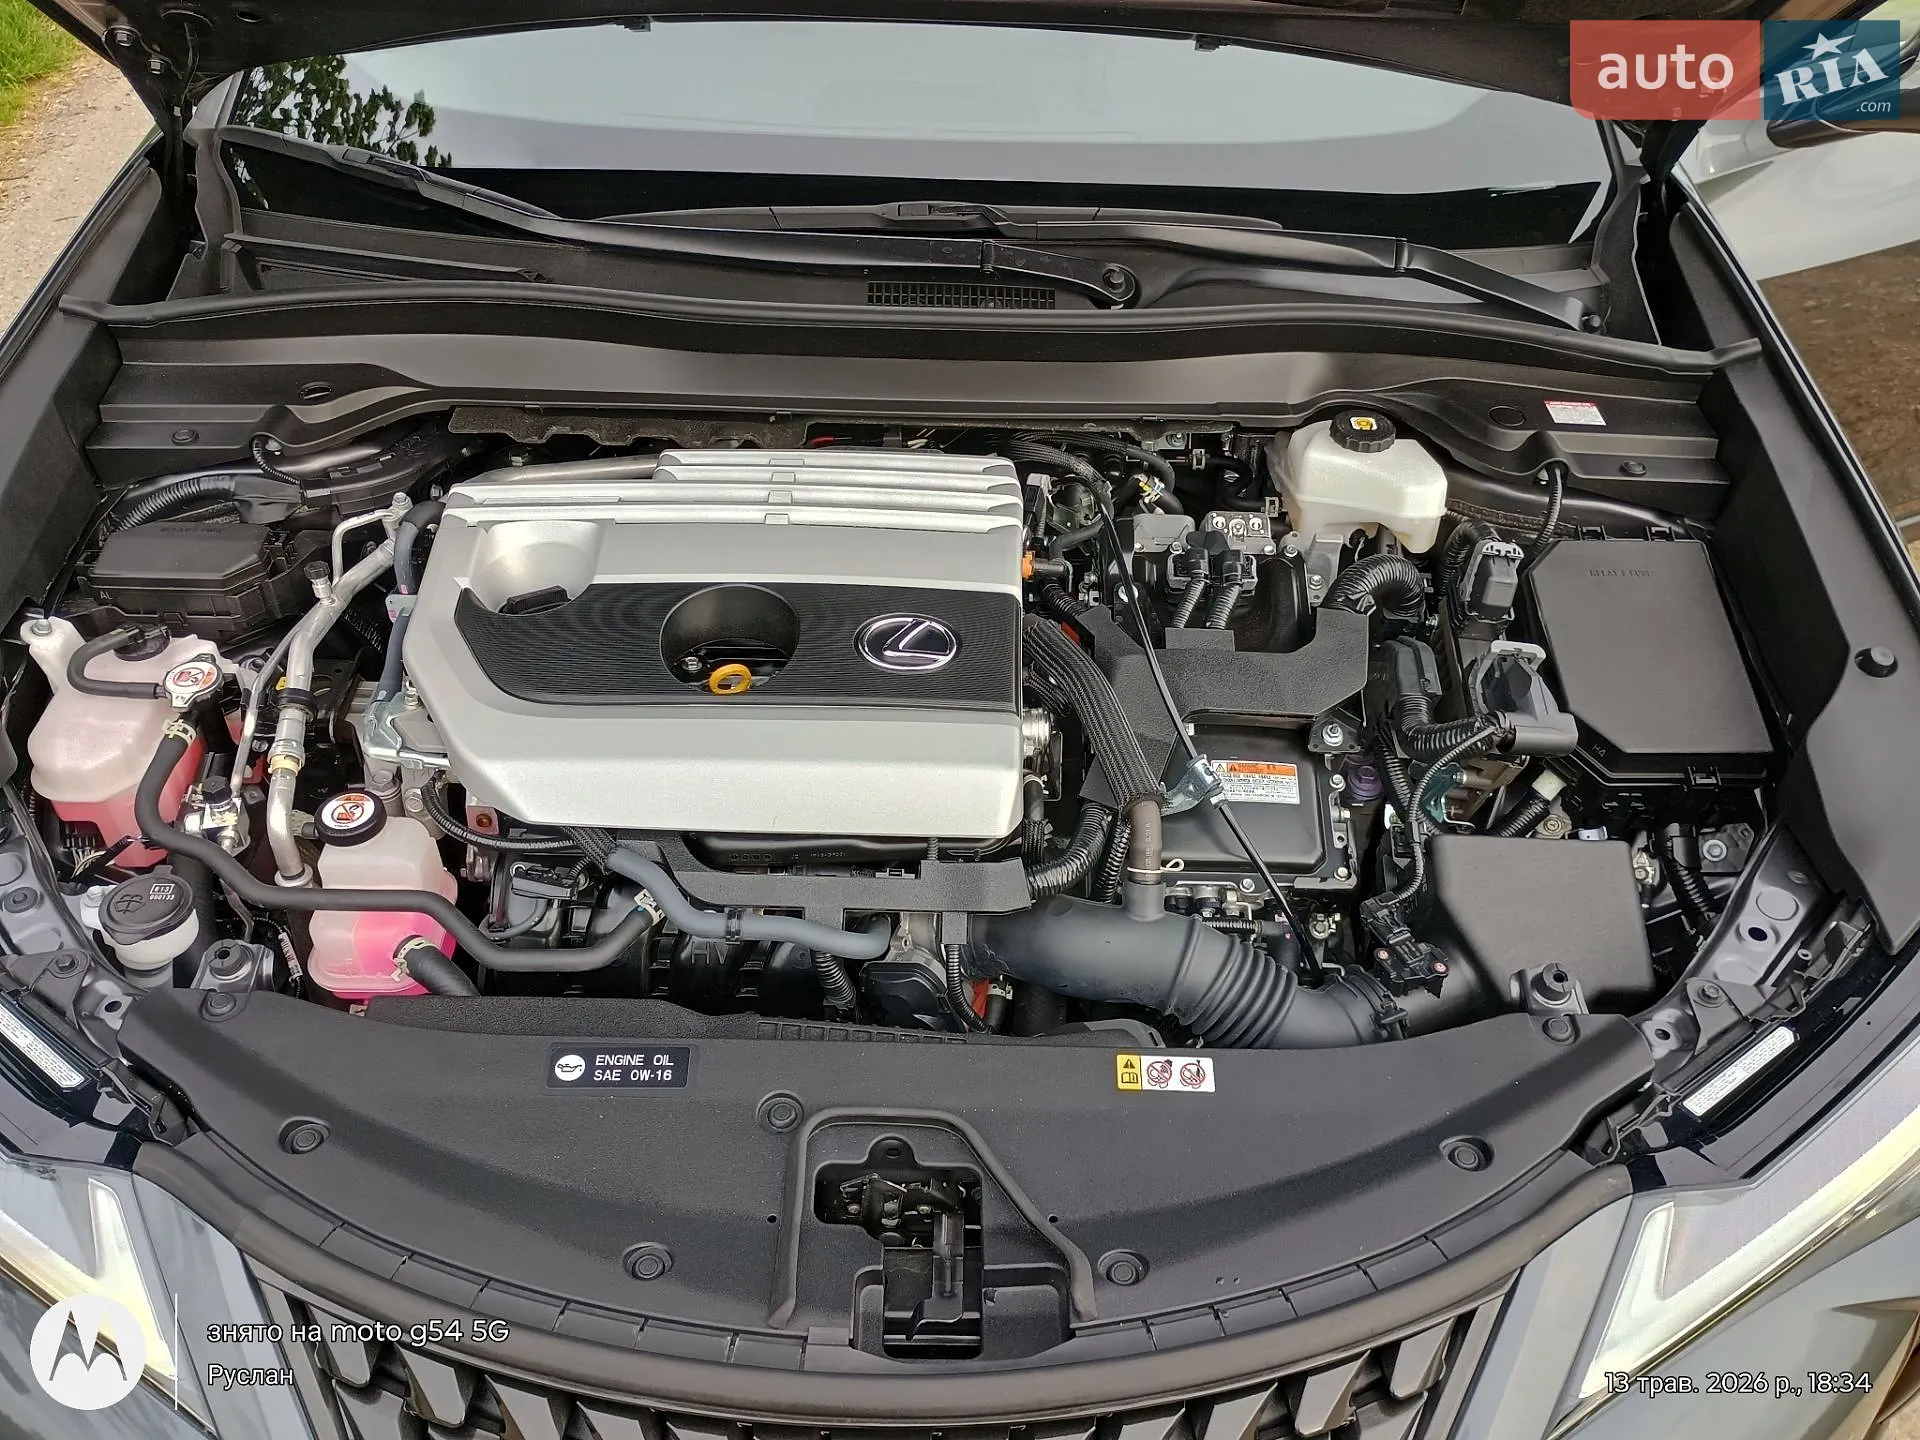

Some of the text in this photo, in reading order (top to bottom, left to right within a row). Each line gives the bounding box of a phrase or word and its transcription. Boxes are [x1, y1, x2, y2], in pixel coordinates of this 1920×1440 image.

[595, 1054, 675, 1066] ENGINE OIL
[593, 1069, 673, 1081] SAE 0W-16
